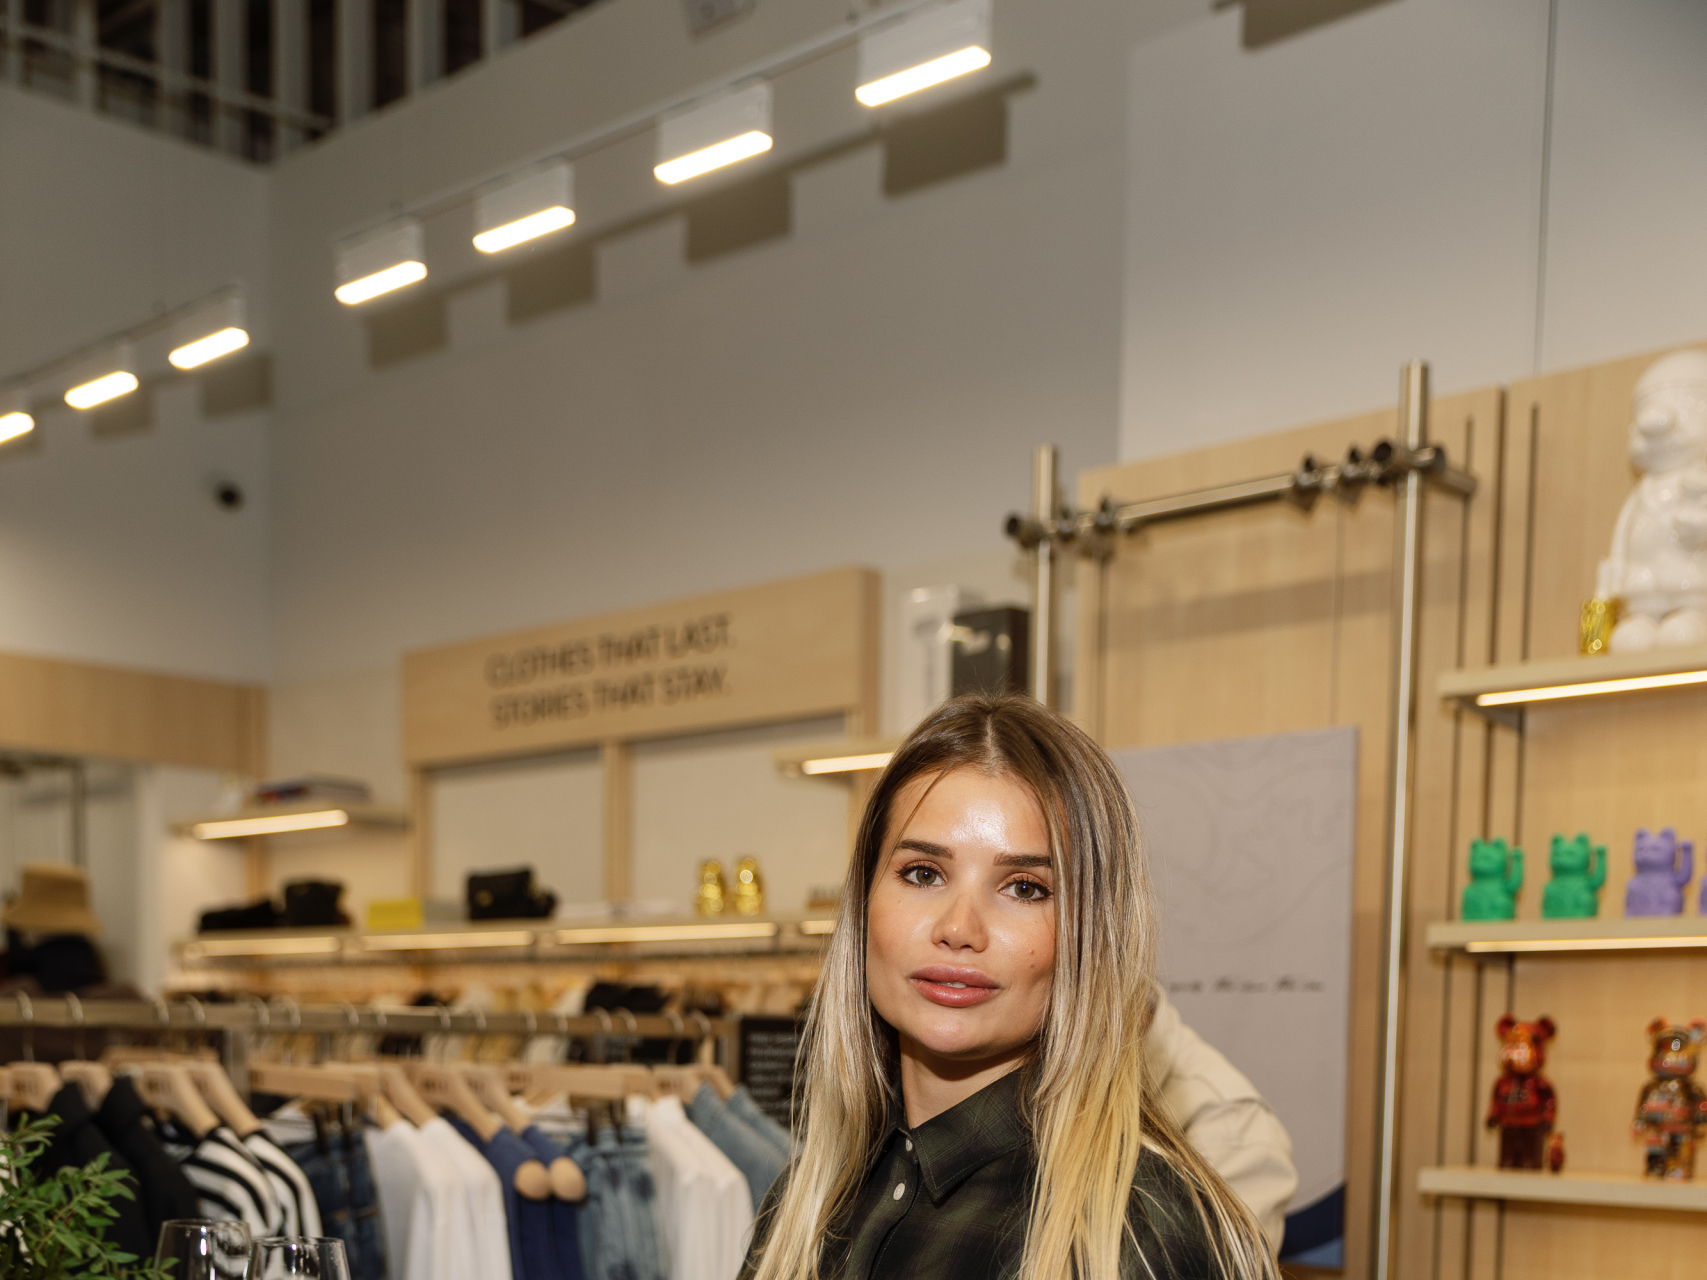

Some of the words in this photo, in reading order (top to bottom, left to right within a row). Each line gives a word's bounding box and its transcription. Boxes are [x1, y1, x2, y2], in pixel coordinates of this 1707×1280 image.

[486, 643, 593, 687] CLOTHES
[597, 627, 660, 666] THAT
[489, 686, 589, 730] STORIES
[592, 673, 655, 711] THAT
